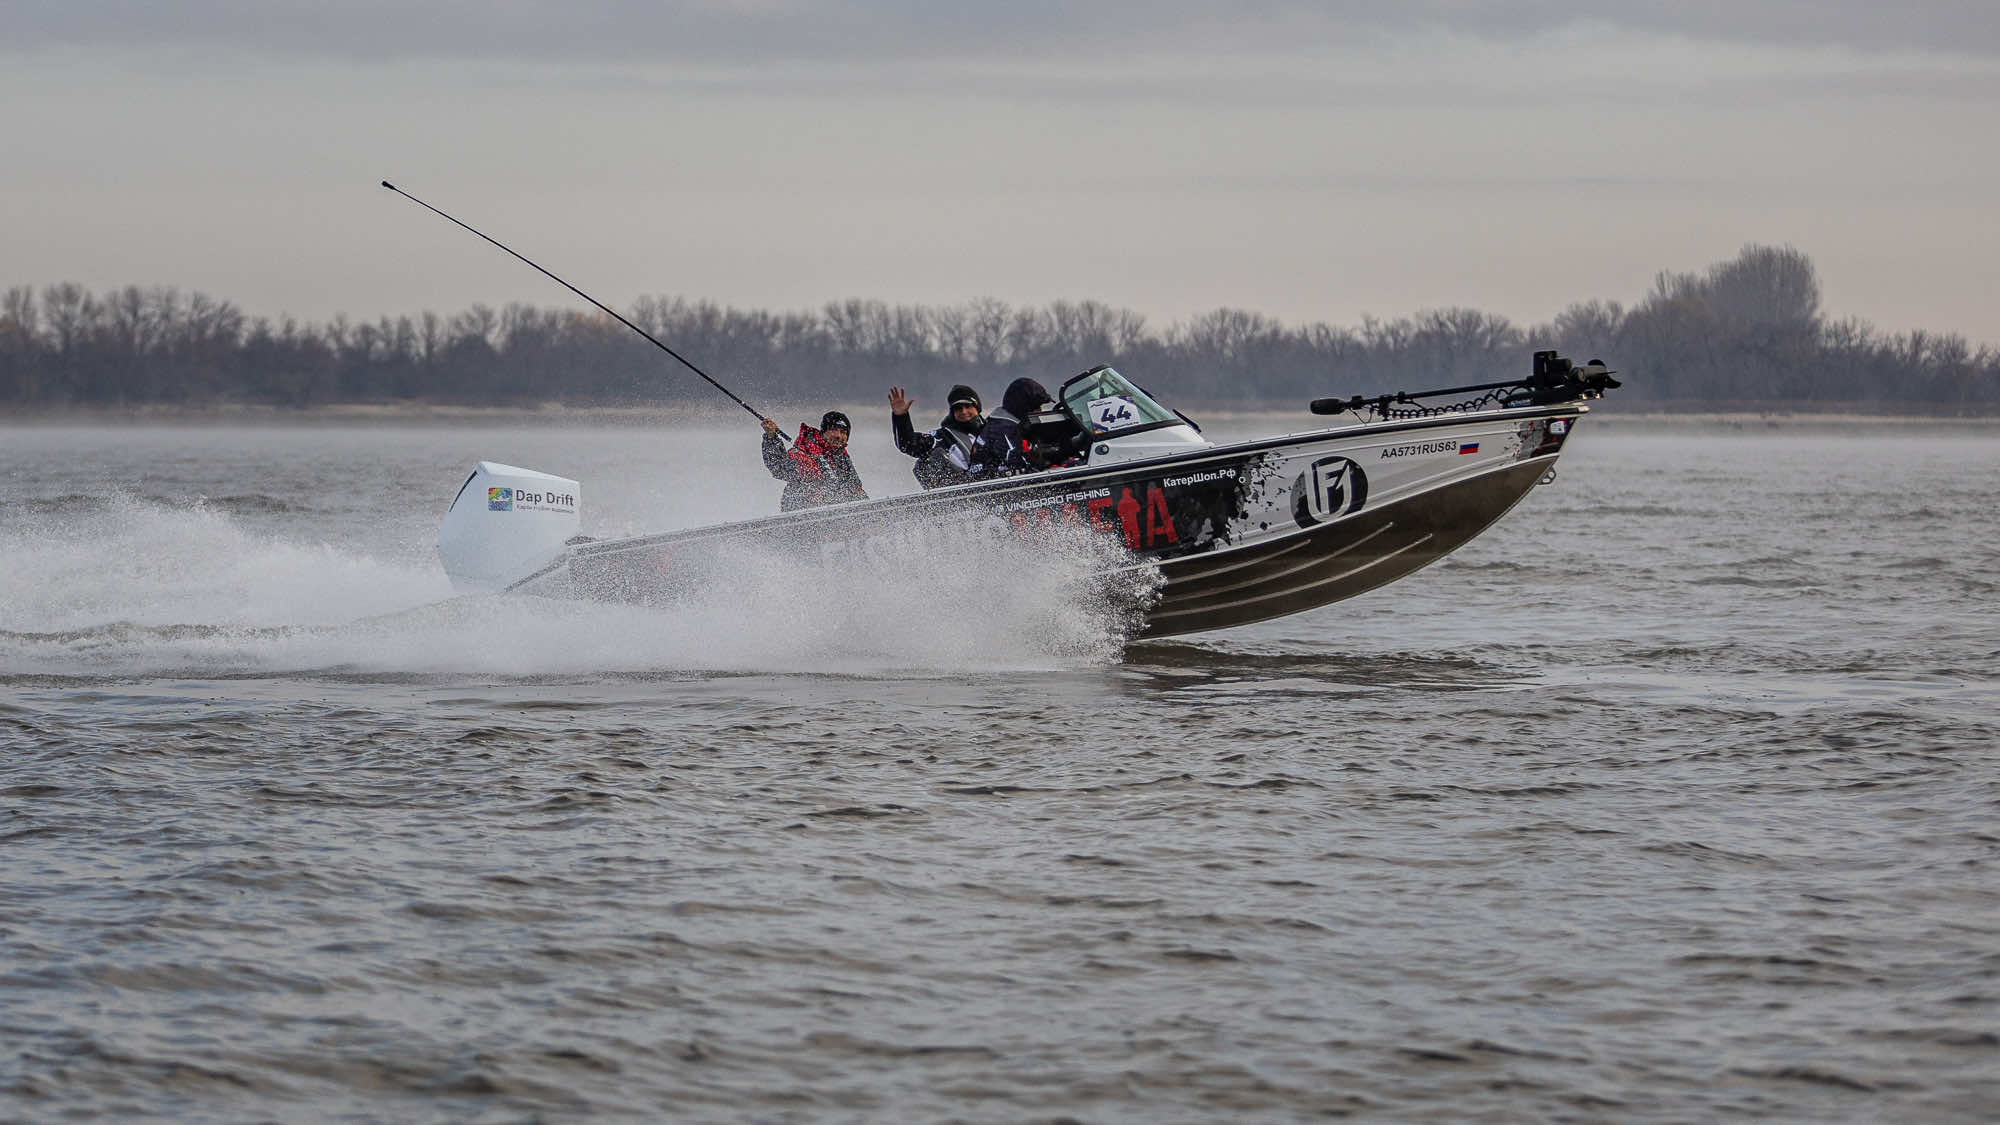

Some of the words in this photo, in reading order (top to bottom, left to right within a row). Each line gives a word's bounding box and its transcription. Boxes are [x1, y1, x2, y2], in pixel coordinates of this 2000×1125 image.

[1101, 405, 1131, 423] 44
[1381, 441, 1456, 459] AA5731RUS63
[516, 490, 542, 505] Dap
[546, 492, 574, 506] Drift
[1065, 488, 1110, 502] FISHING
